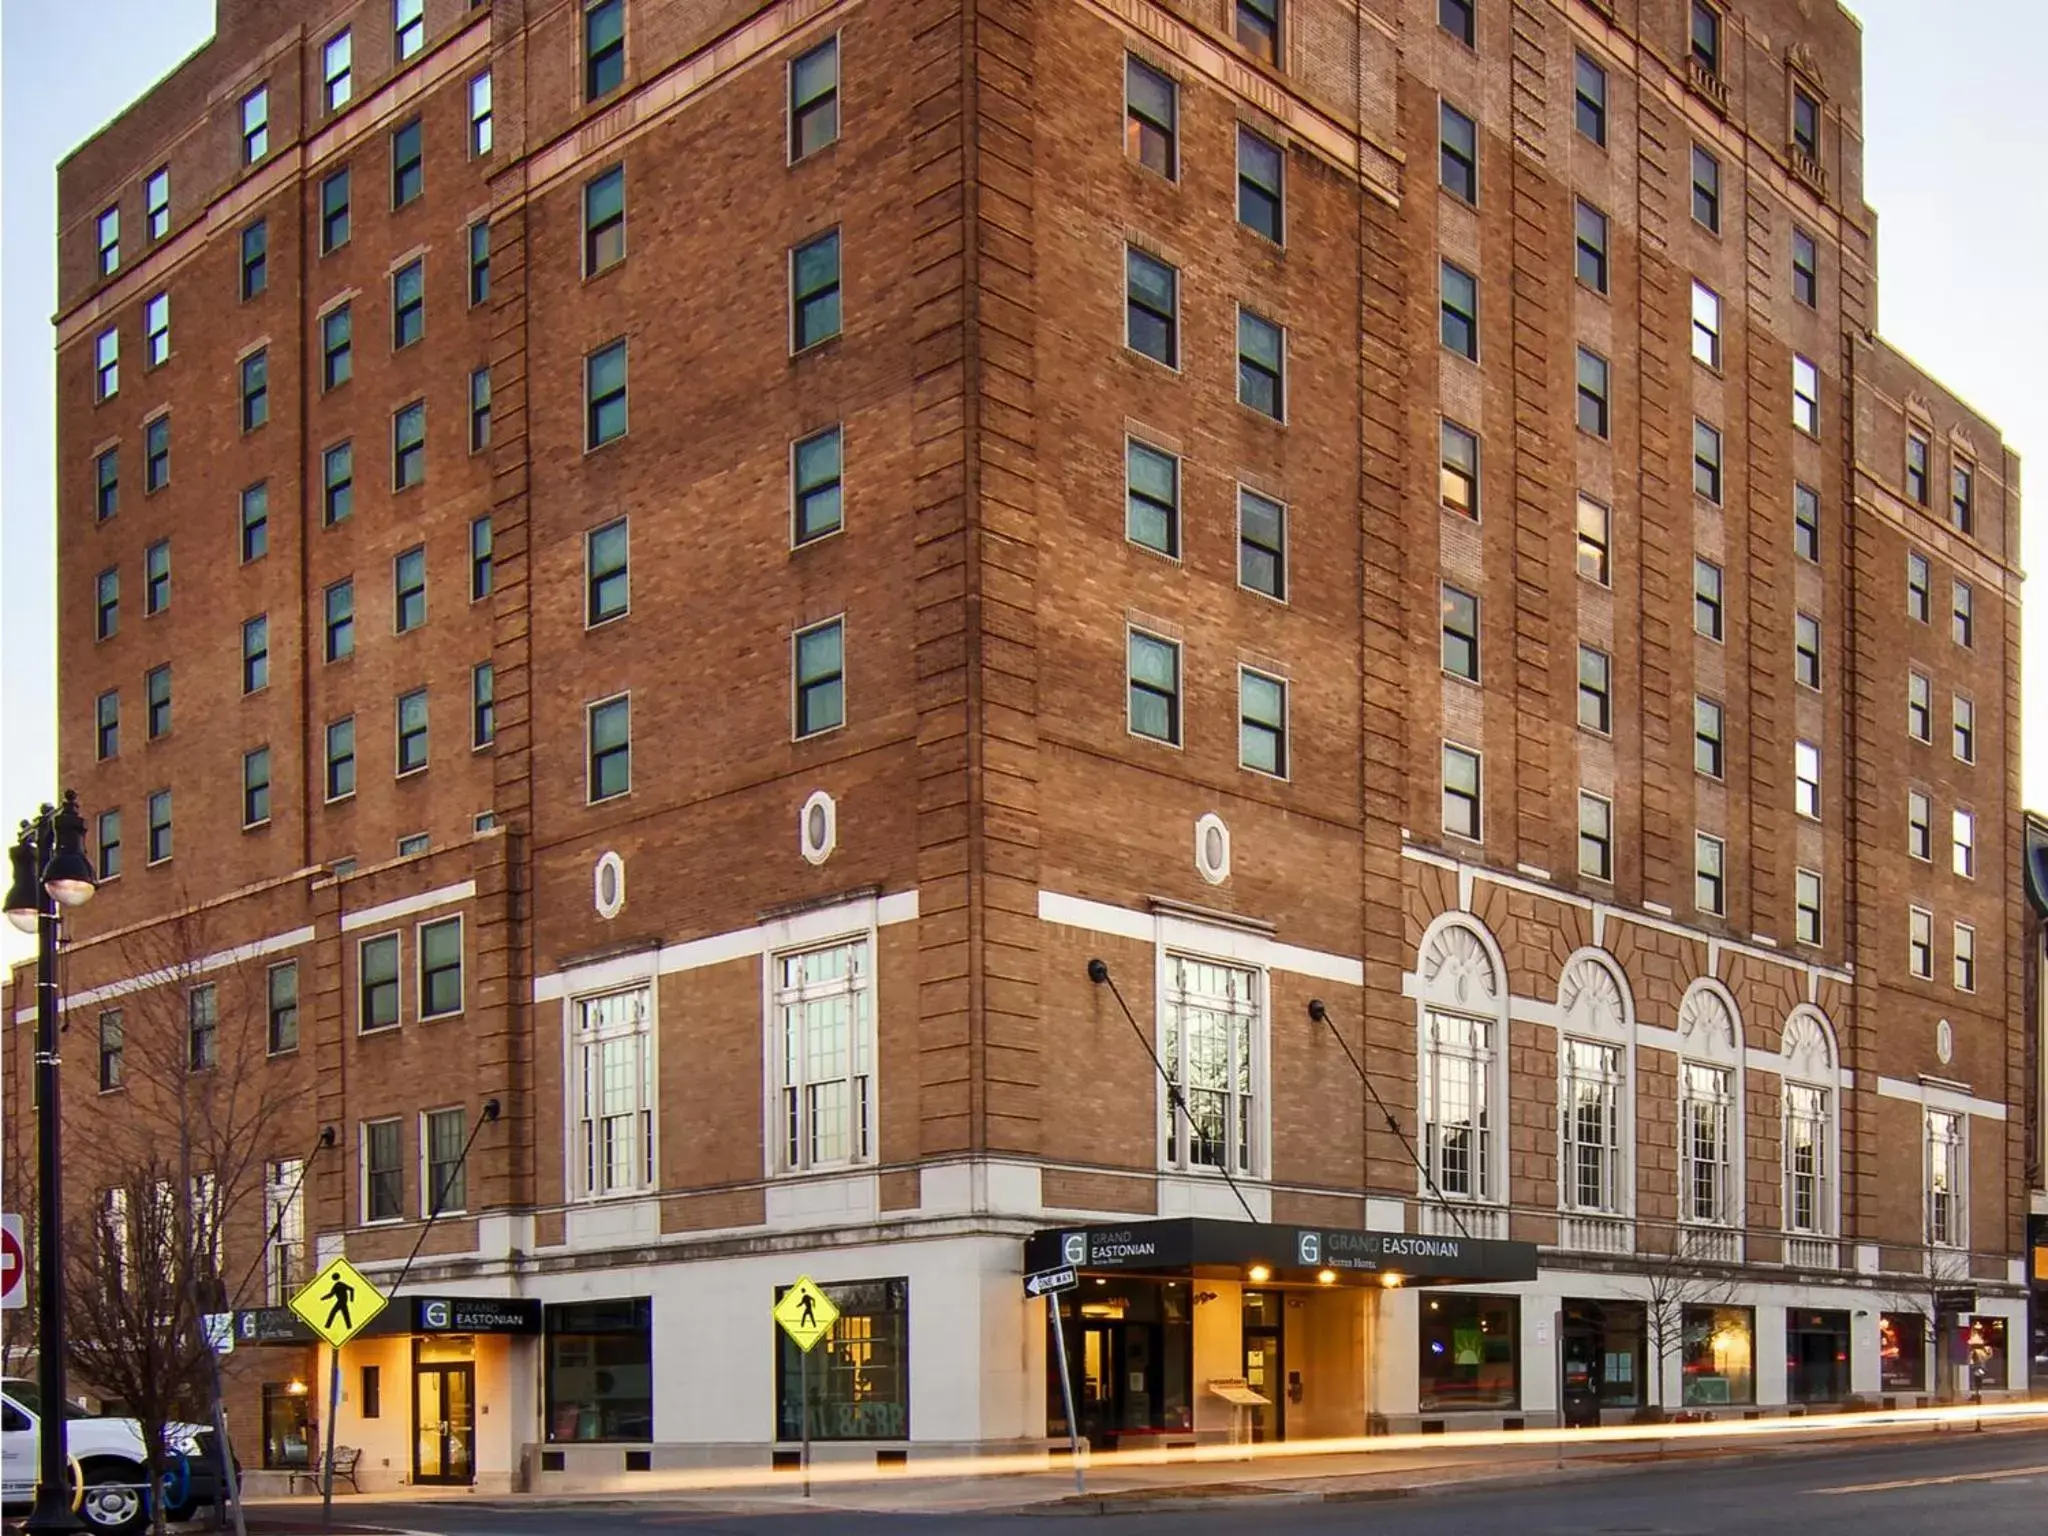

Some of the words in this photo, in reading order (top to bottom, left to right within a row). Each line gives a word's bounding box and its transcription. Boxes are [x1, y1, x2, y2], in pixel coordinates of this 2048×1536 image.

[1092, 1231, 1132, 1244] GRAND
[1091, 1243, 1155, 1259] EASTONIAN
[1328, 1234, 1379, 1253] GRAND
[1382, 1238, 1459, 1257] EASTONIAN
[455, 1313, 524, 1325] EASTONIAN
